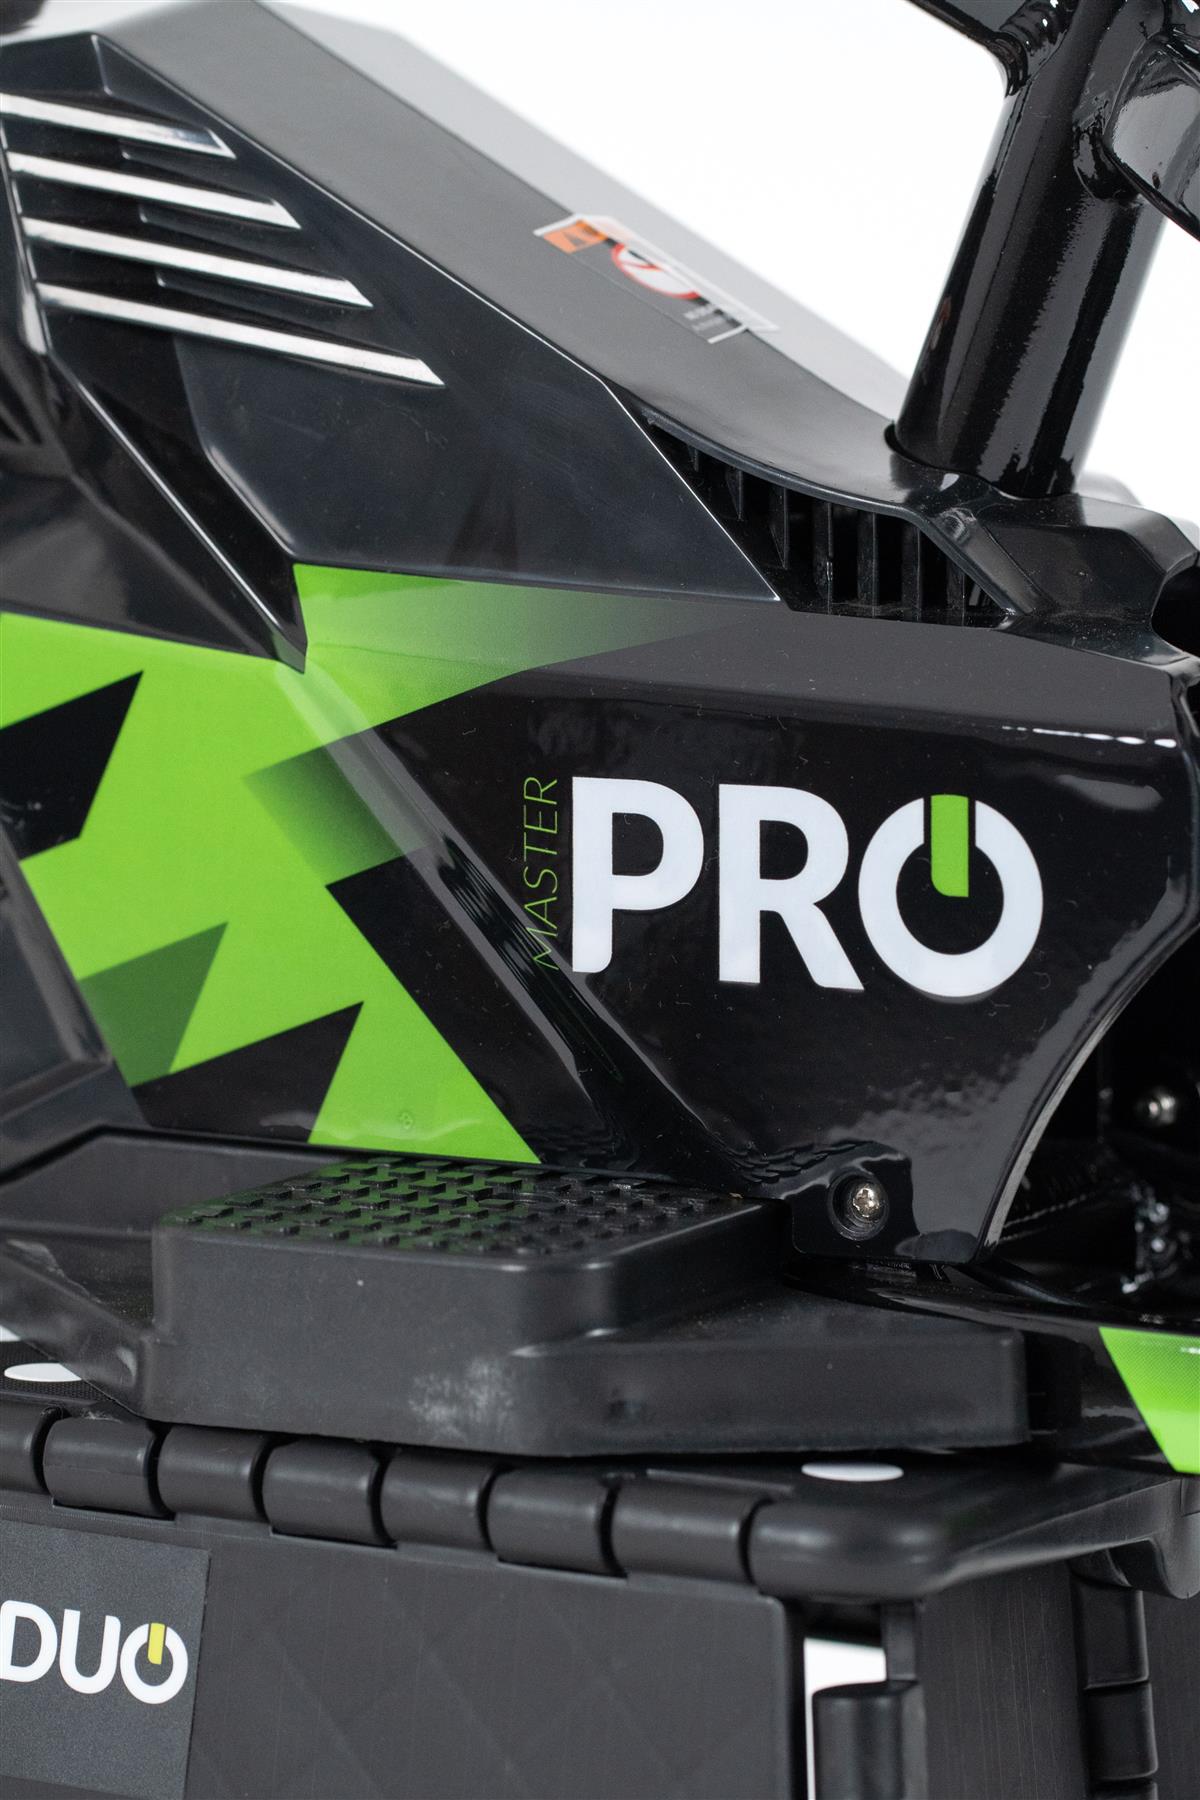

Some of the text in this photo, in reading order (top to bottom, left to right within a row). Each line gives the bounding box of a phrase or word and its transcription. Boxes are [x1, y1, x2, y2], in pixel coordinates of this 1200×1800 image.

[523, 776, 559, 971] MASTER
[572, 776, 1043, 997] PRO
[0, 1600, 188, 1704] DUO
